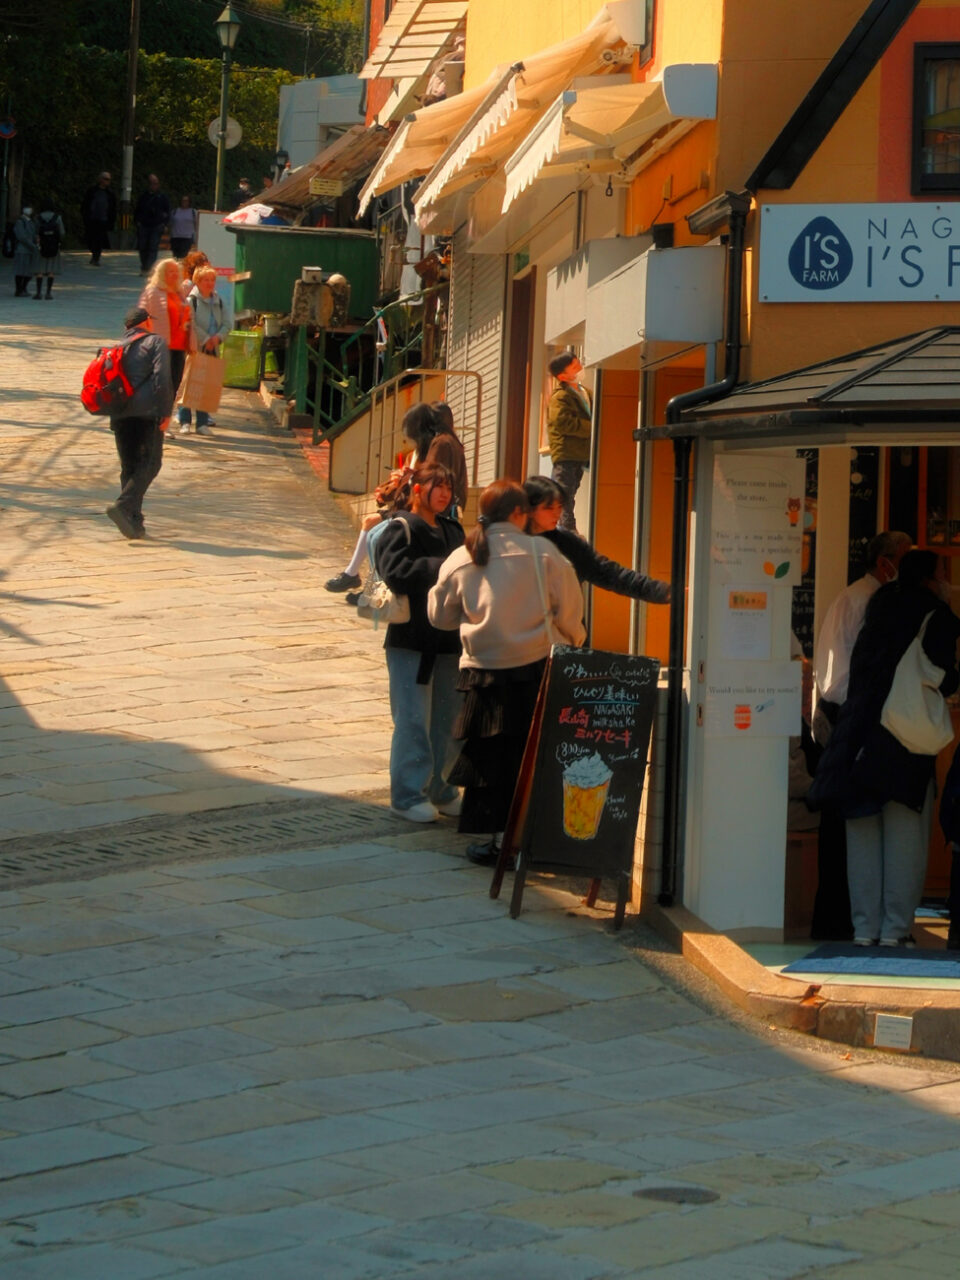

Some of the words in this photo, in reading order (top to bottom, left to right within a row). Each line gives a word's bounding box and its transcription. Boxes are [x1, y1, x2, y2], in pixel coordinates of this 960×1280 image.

[804, 233, 840, 269] I'S
[803, 270, 840, 282] FARM
[867, 244, 924, 288] I'S
[559, 707, 590, 728] 長崎
[593, 704, 635, 716] NAGASAKI
[574, 728, 633, 749] ミルクセーキ
